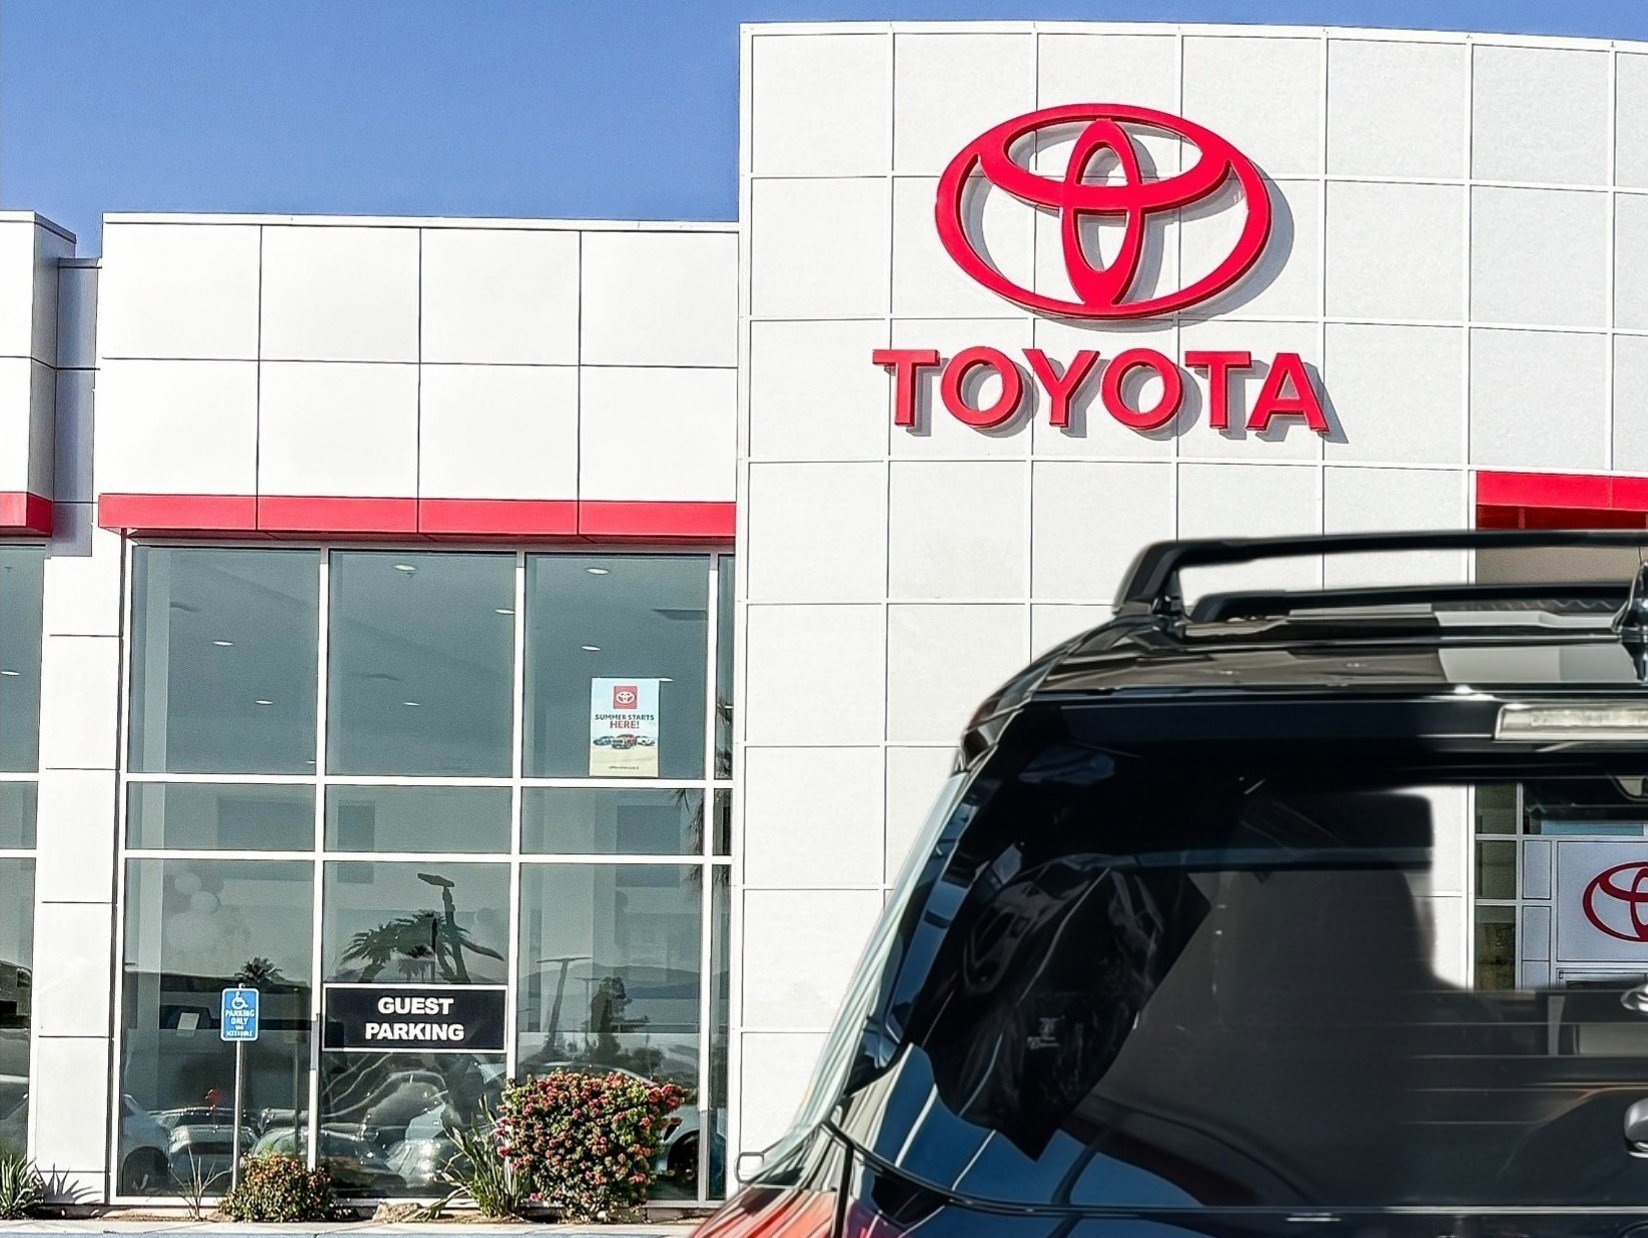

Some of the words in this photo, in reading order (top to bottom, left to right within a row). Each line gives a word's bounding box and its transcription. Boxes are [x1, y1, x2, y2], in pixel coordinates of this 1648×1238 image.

[873, 346, 1330, 433] TOYOTA
[609, 721, 640, 729] HERE!
[377, 997, 454, 1015] GUEST
[365, 1023, 464, 1041] PARKING
